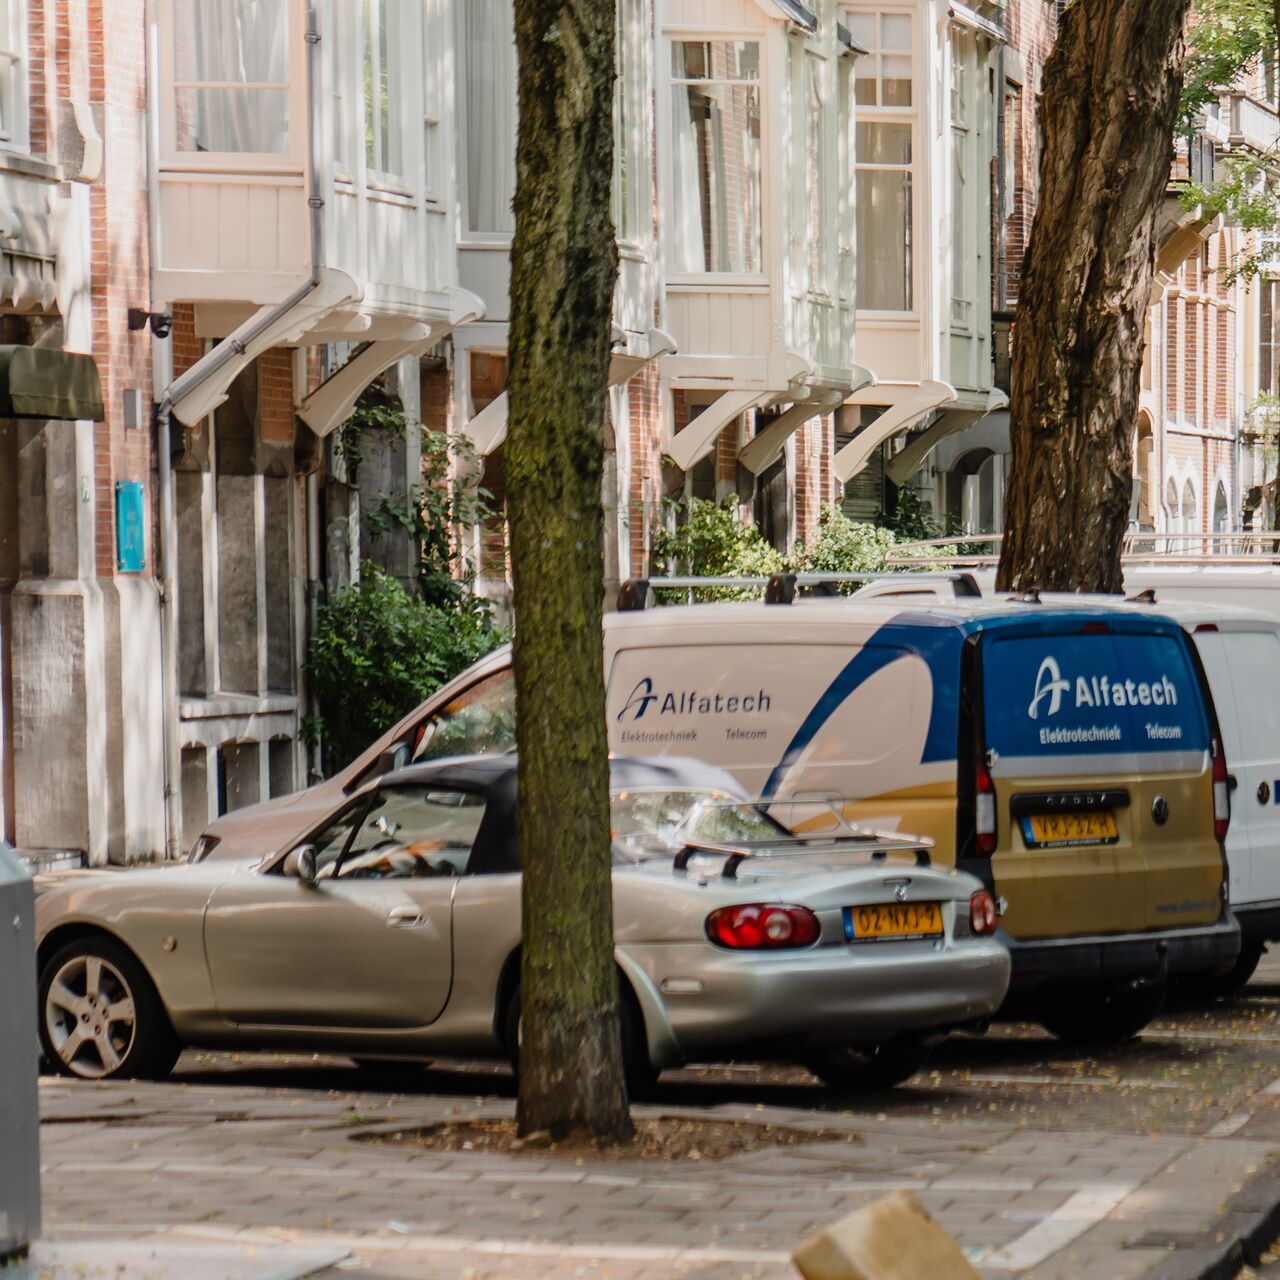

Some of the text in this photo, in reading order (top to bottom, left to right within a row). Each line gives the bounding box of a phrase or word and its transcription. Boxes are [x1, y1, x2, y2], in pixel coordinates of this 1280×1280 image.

[660, 688, 771, 715] Alfatech
[1075, 673, 1178, 708] Alfatech
[621, 728, 767, 743] Elektrotechniek Telecom
[1039, 722, 1181, 744] Elektrotechniek Telecom
